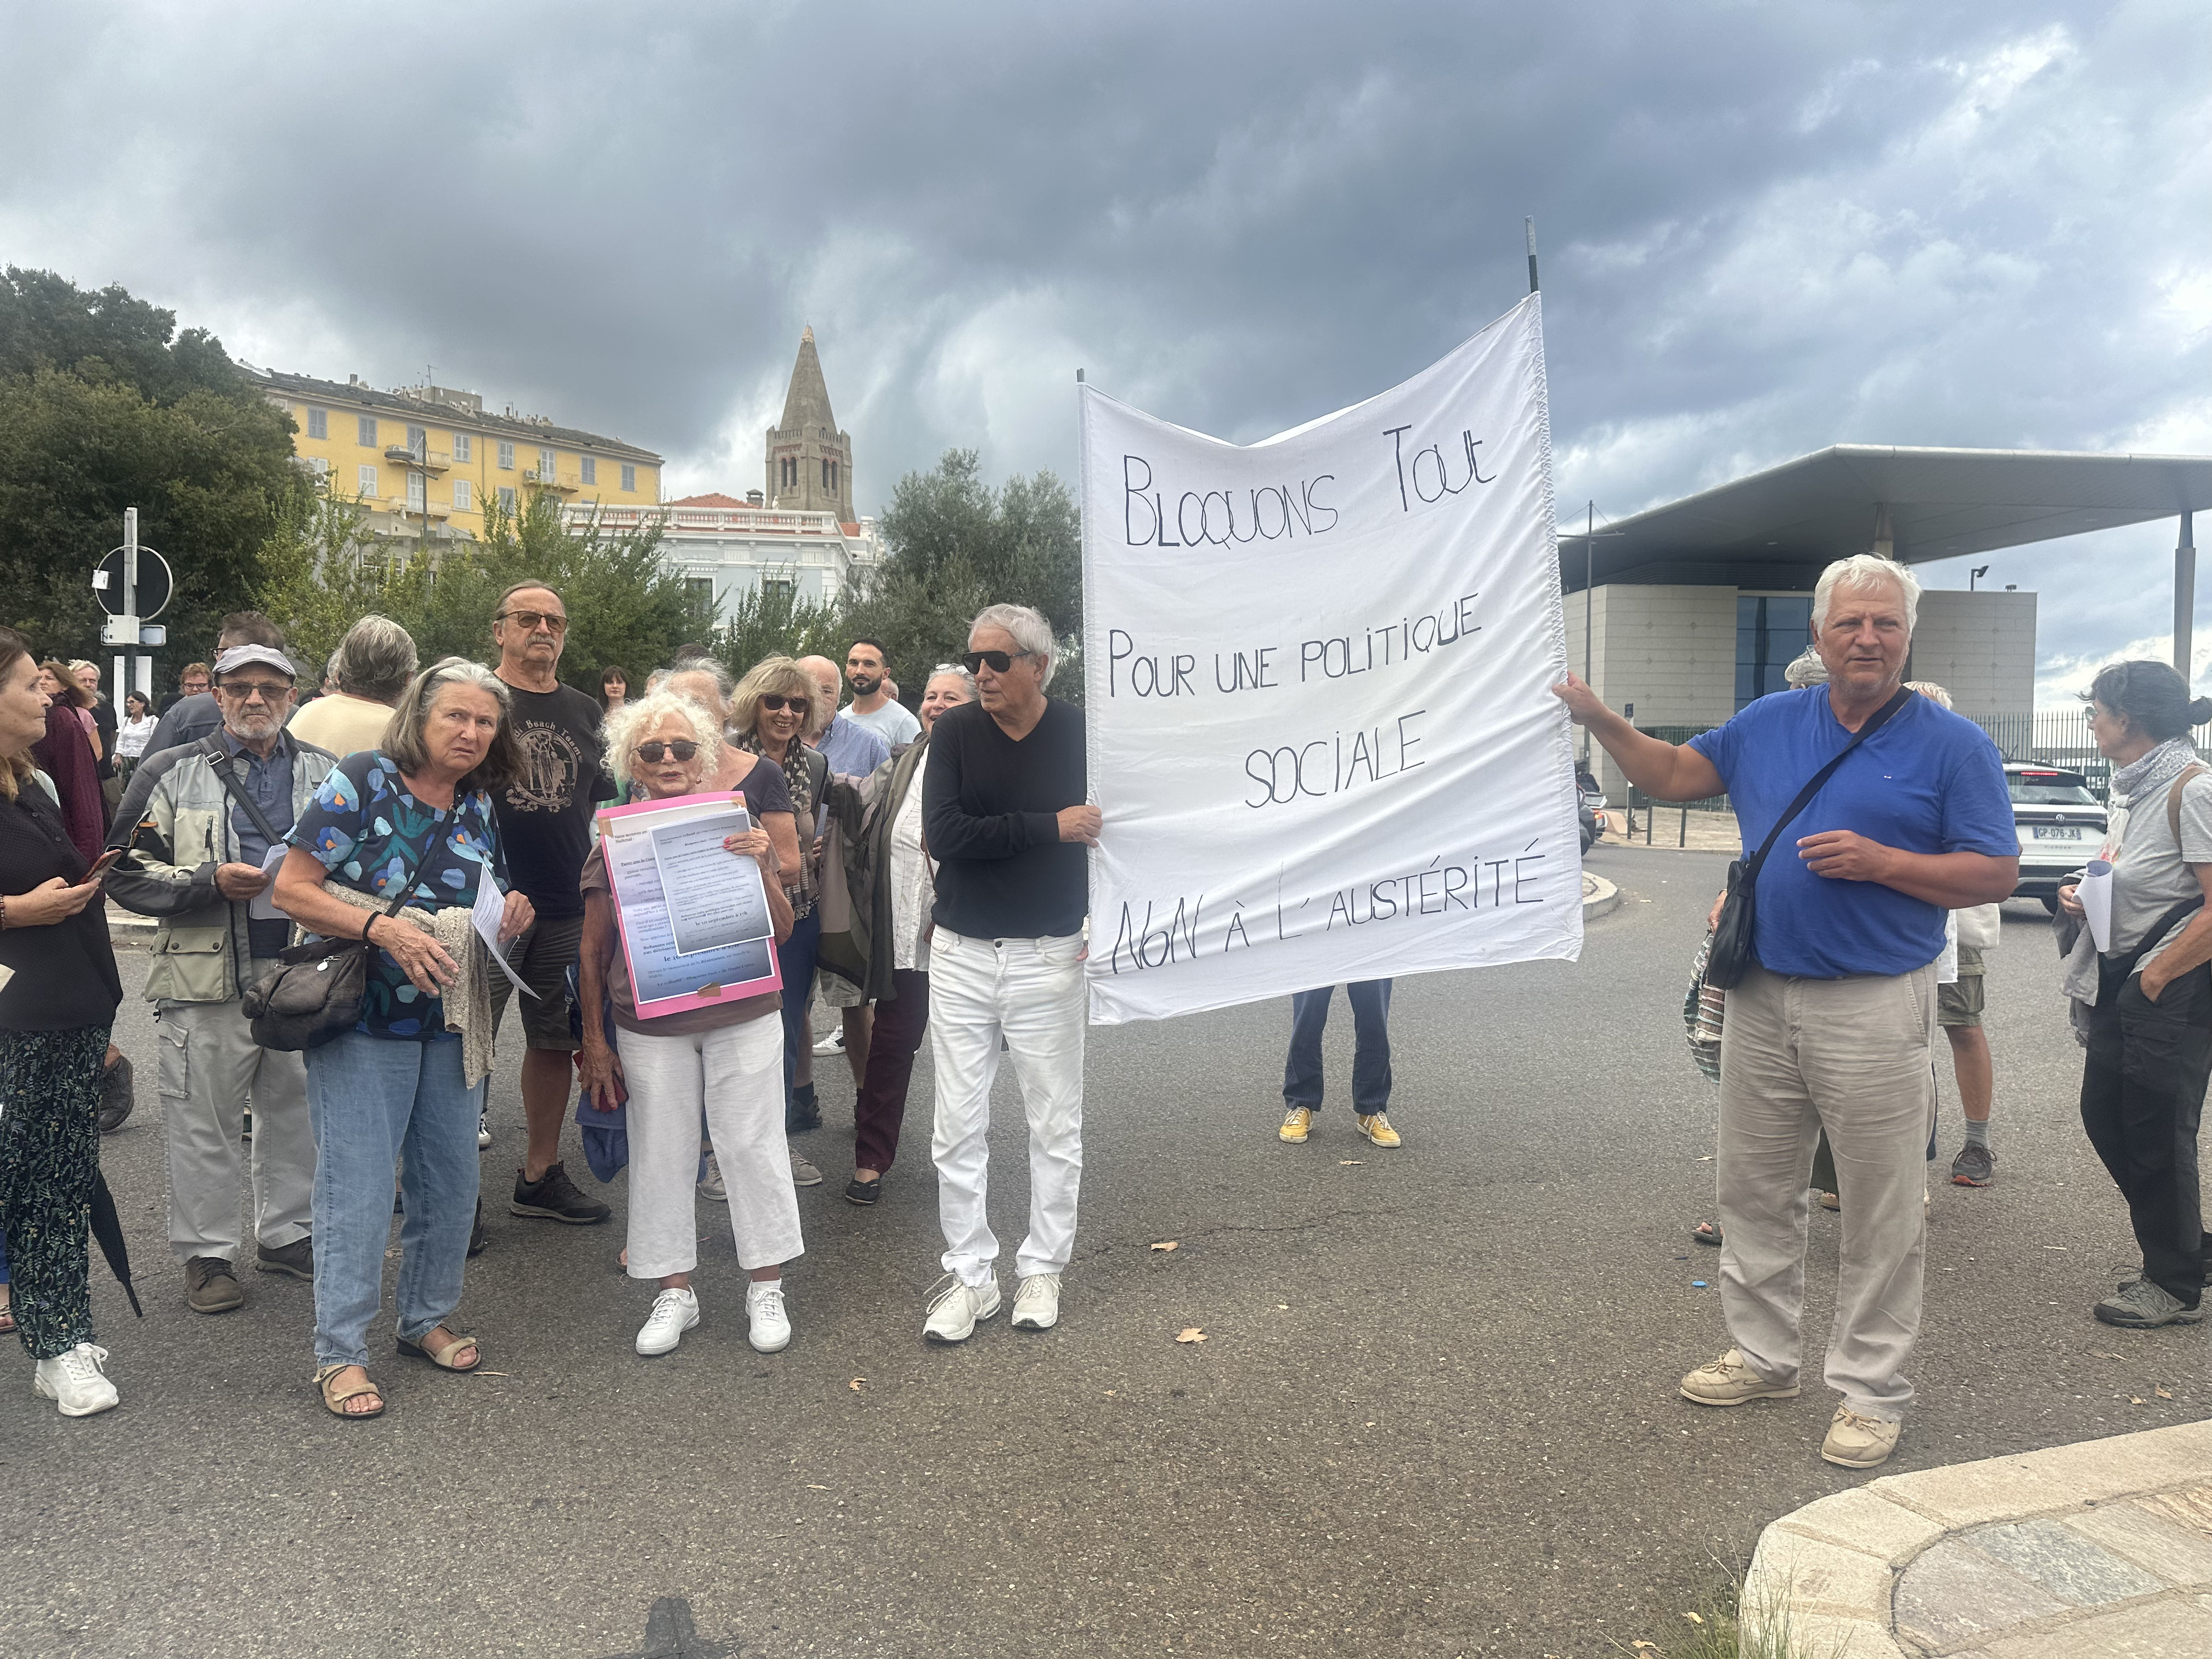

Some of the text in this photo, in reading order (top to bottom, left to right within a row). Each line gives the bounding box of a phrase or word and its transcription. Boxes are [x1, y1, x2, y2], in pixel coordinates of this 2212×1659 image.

[1124, 454, 1339, 550] BLOQUONS
[1110, 629, 1196, 698] POUR
[1215, 647, 1279, 693] UNE
[526, 719, 556, 731] Beach
